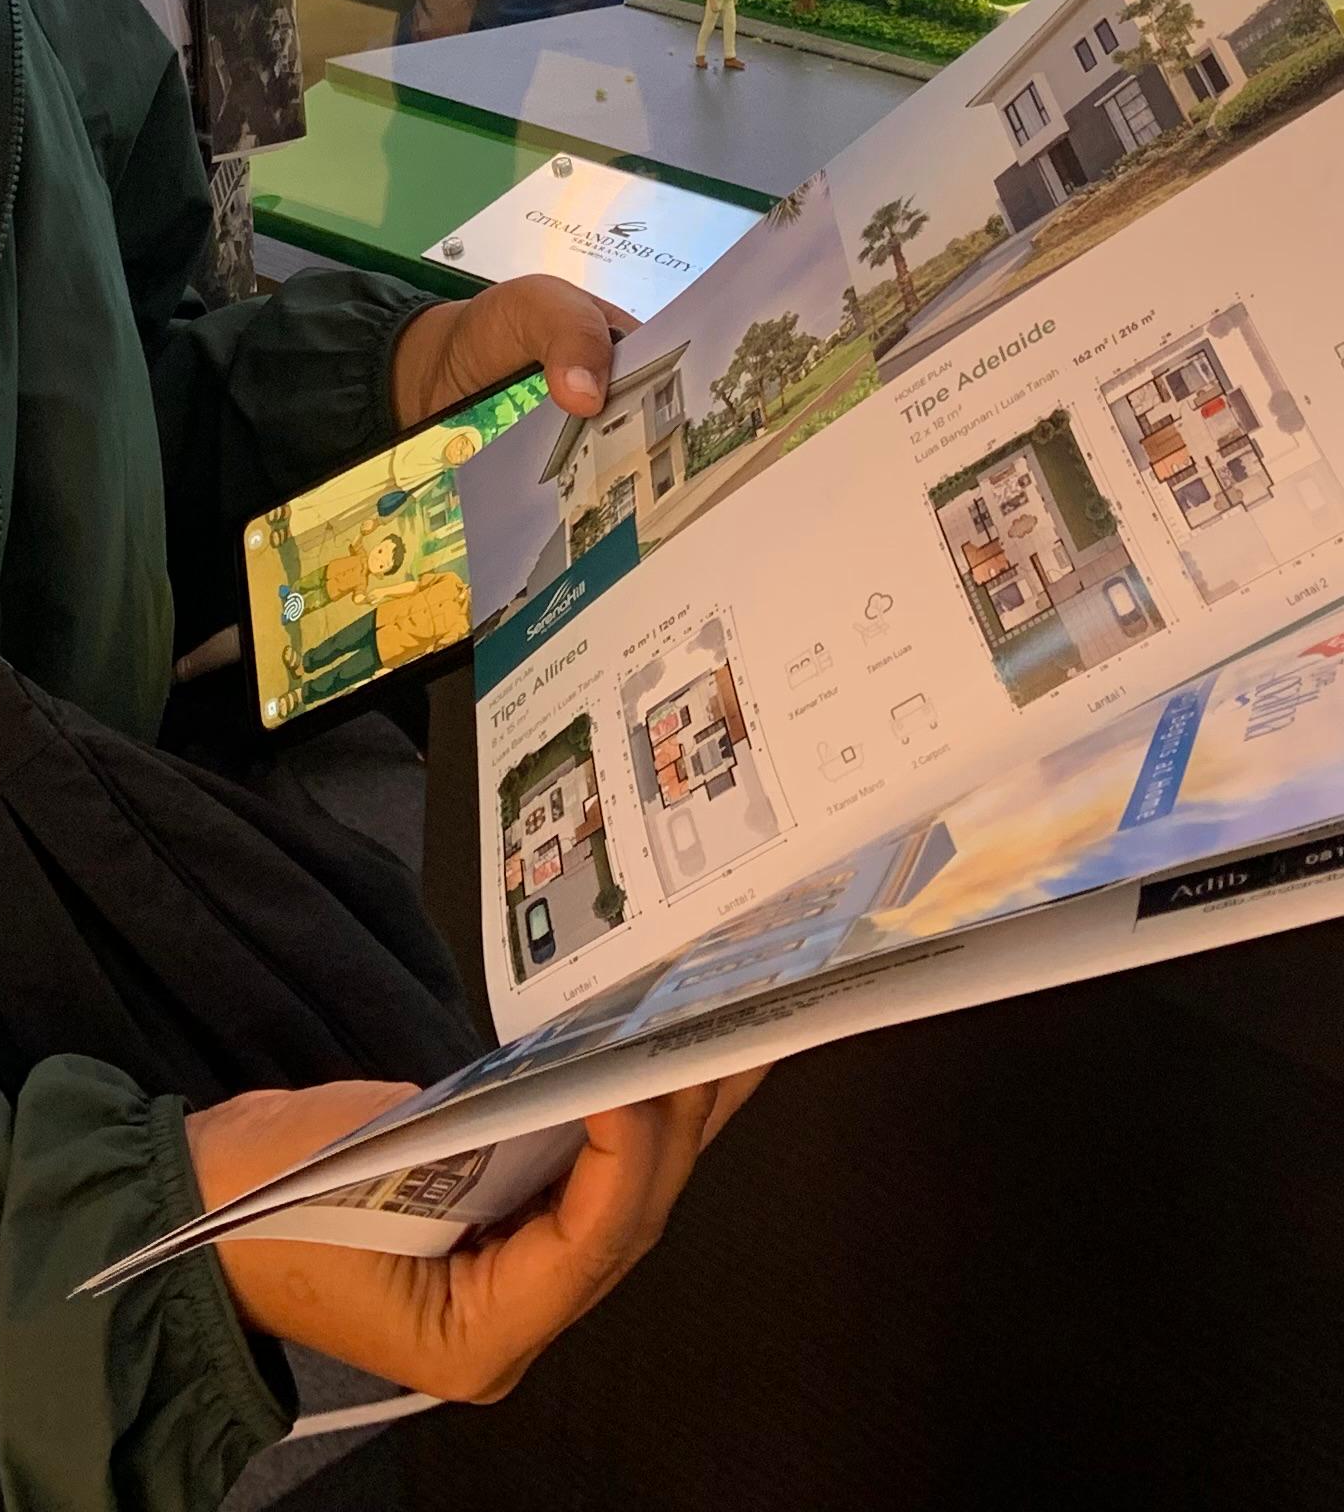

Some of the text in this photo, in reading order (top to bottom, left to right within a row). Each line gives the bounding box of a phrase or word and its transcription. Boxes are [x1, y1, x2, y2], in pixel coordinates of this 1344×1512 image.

[615, 239, 656, 259] BSB
[1073, 349, 1092, 367] 162
[1119, 322, 1139, 340] 216
[894, 360, 953, 403] HOUSE PLAN
[900, 318, 1057, 426] Tipe Adelaide
[914, 368, 1060, 465] Luas Bangunan Luas Tanah
[1286, 577, 1329, 607] Lantai 2
[623, 647, 635, 658] 90
[659, 616, 675, 632] 120
[867, 644, 912, 675] Taman Luas
[578, 670, 604, 691] Tanah
[490, 692, 526, 728] Tipe
[795, 699, 818, 719] Kamar
[1087, 691, 1120, 714] Lantai
[918, 744, 951, 766] Carport
[833, 793, 858, 813] Kamar
[718, 895, 748, 916] Lantai
[563, 980, 592, 1002] Lantai
